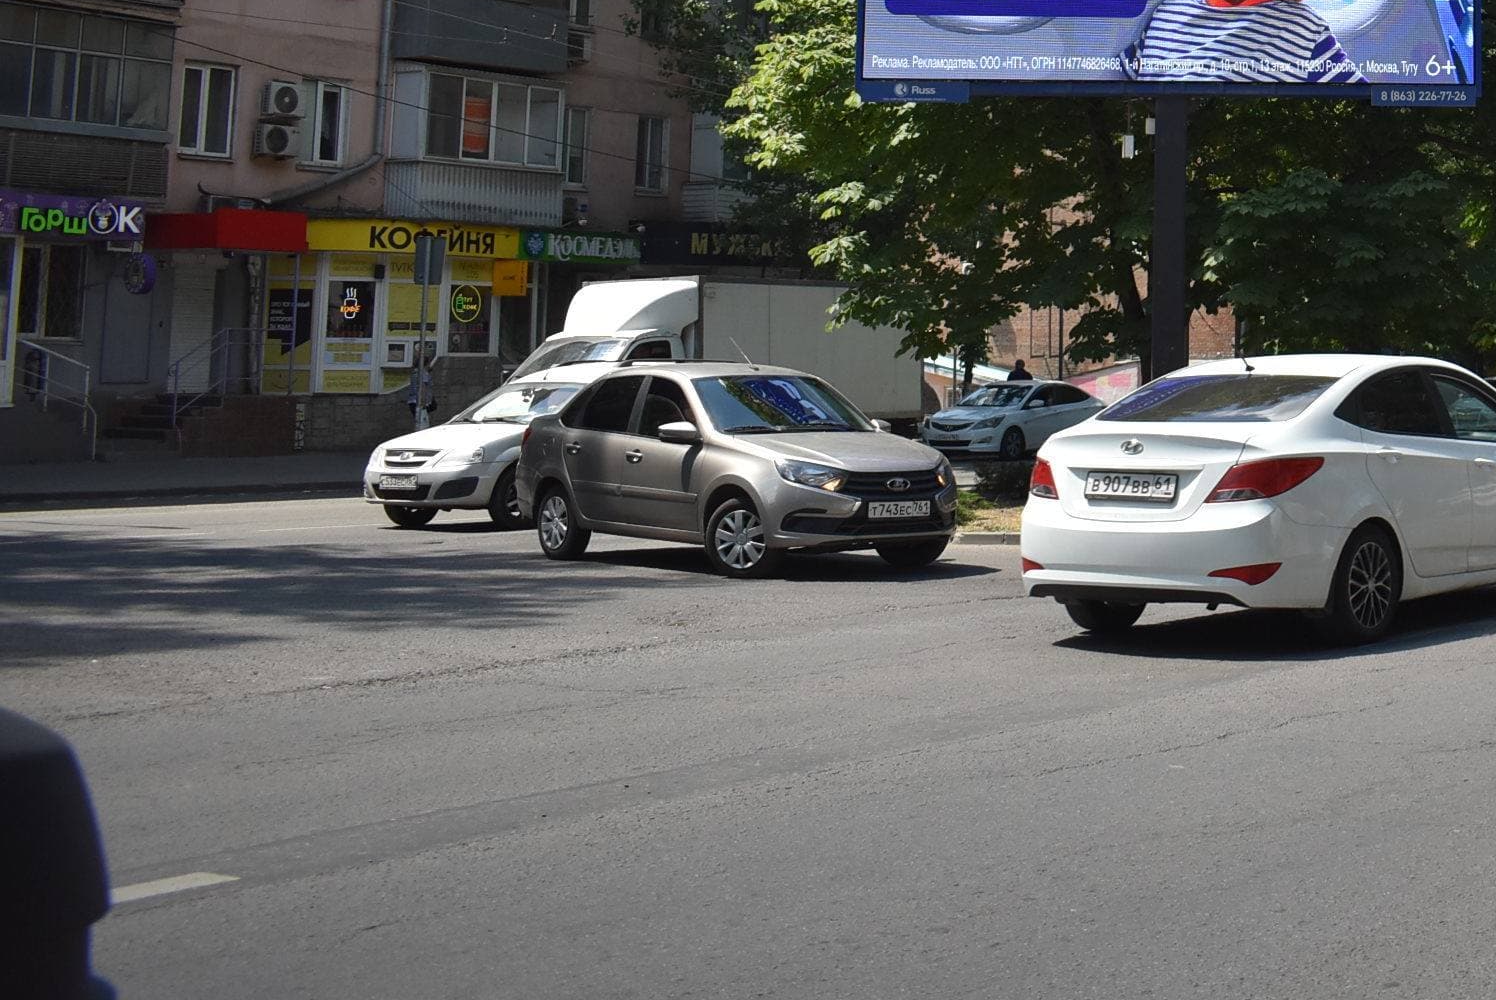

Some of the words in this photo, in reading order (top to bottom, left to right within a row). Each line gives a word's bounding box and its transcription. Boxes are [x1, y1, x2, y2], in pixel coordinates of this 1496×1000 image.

[872, 55, 910, 69] Реклама.
[912, 55, 978, 70] Рекламодатель:
[980, 56, 1001, 69] ООО
[1031, 56, 1056, 69] ОГРН
[1366, 60, 1400, 74] Москва,
[1401, 60, 1419, 76] Туту
[1425, 54, 1457, 77] 6+
[911, 85, 936, 95] Russ
[1391, 90, 1415, 102] (863)
[1419, 90, 1467, 101] 226-77-26
